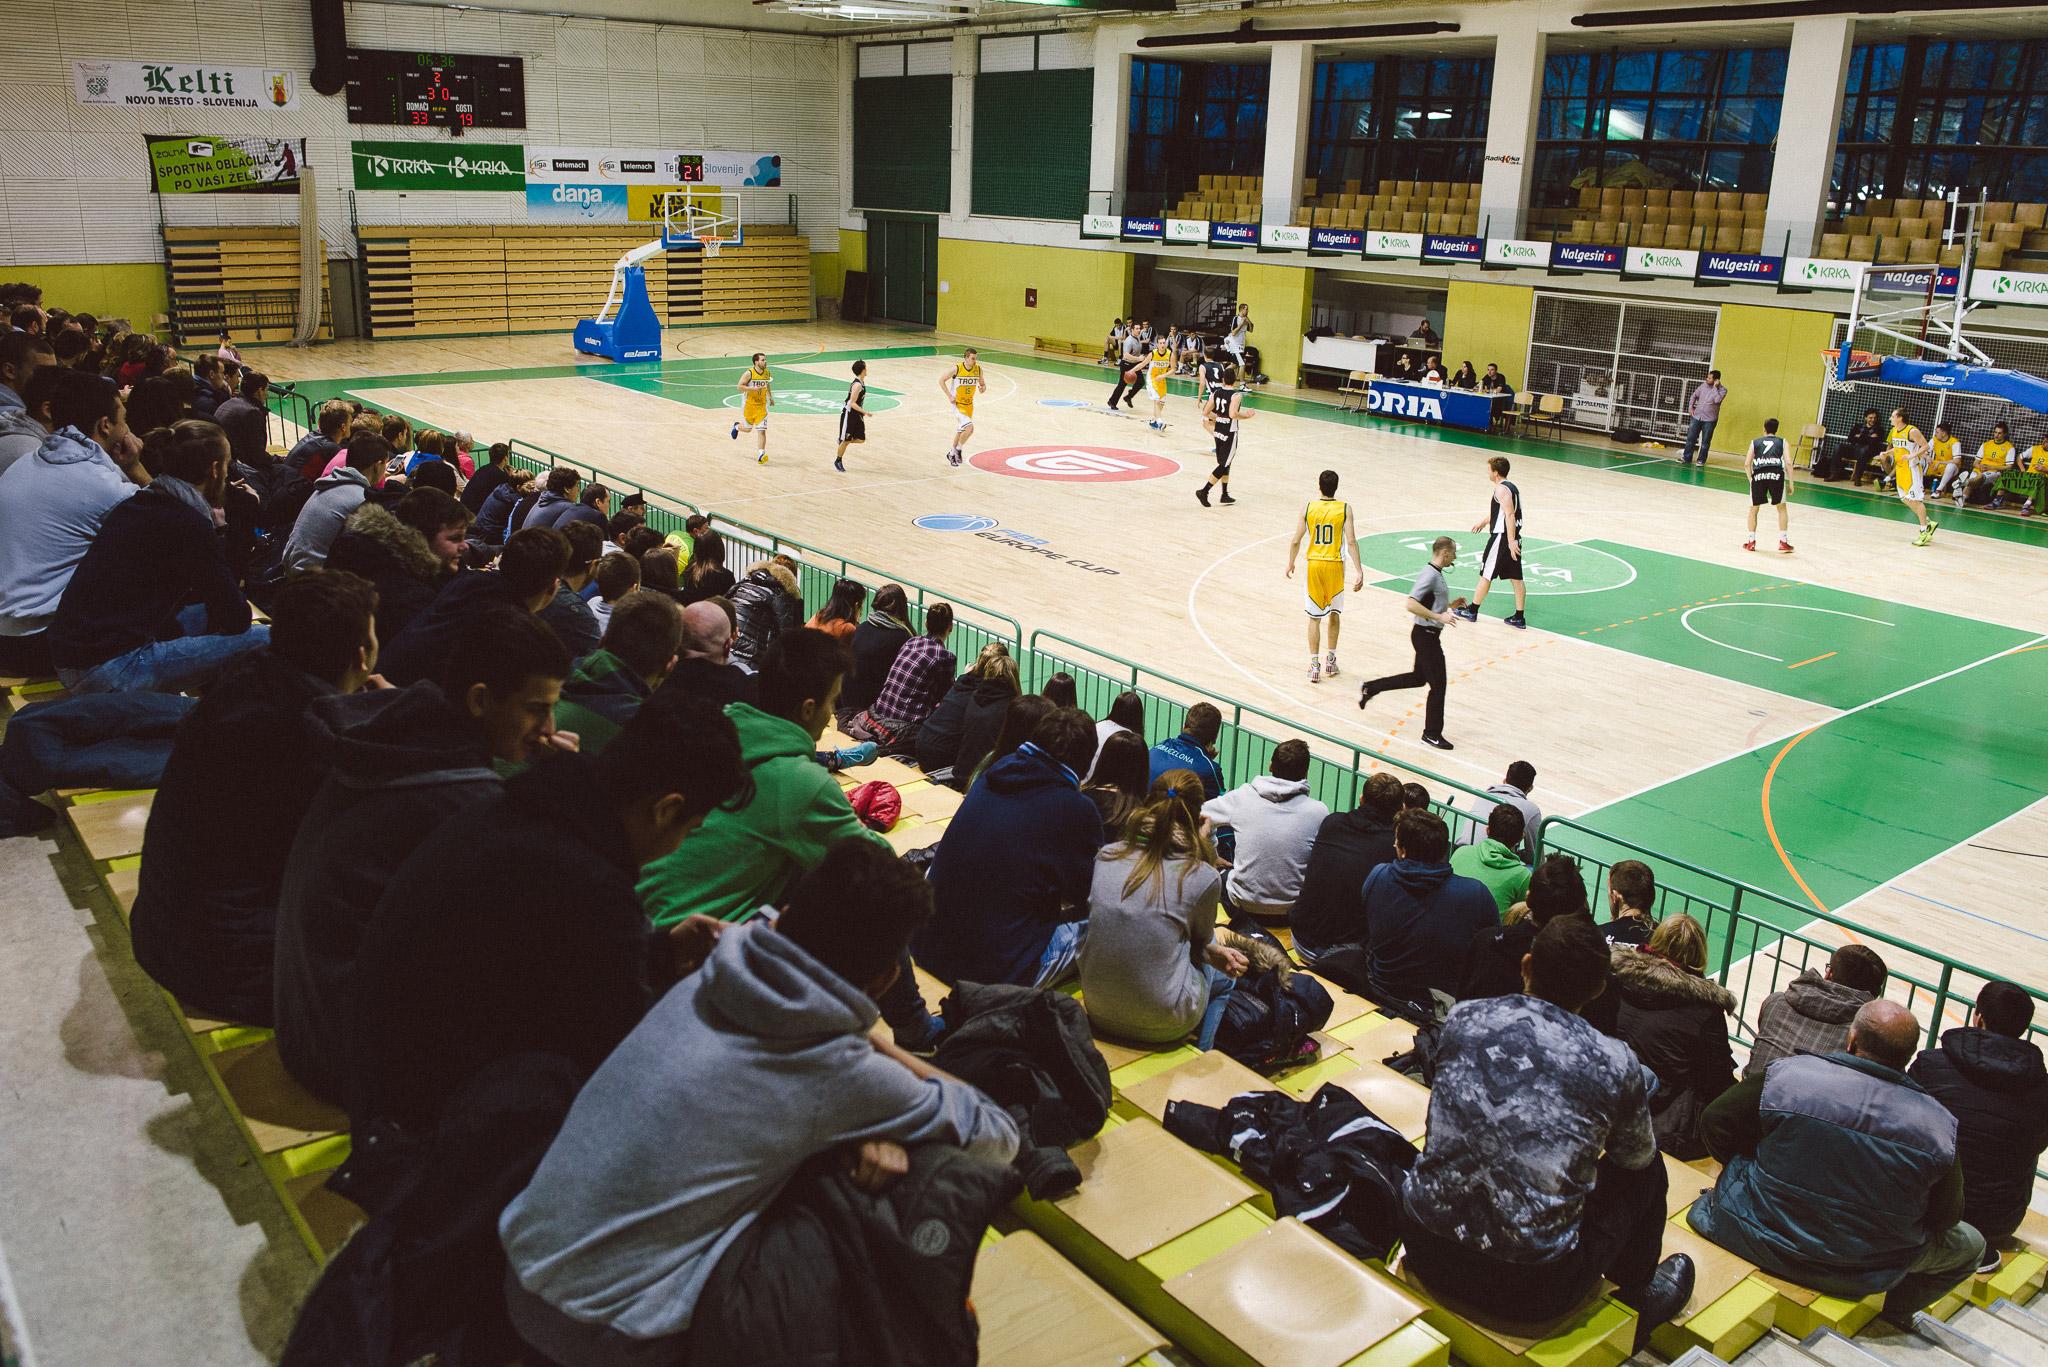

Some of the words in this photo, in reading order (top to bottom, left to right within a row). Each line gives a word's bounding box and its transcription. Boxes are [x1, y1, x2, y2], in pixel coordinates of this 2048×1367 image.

[141, 65, 235, 95] Kelti
[434, 72, 441, 83] 2
[427, 87, 435, 100] 3
[441, 87, 450, 101] 0
[125, 95, 156, 106] NOVO
[158, 96, 194, 106] MESTO
[202, 97, 259, 108] SLOVENIJA
[455, 103, 473, 113] GOSTI
[411, 111, 428, 125] 33
[460, 113, 473, 127] 19
[158, 160, 213, 178] ŠPORTNA
[393, 159, 436, 175] KRKA
[472, 160, 513, 176] KRKA
[555, 161, 586, 169] telemach
[704, 162, 744, 176] Slovenije
[684, 165, 702, 180] 21
[174, 179, 192, 191] PO
[195, 174, 225, 188] VAŠI
[652, 188, 685, 206] vaš
[649, 200, 703, 218] kanal
[1216, 226, 1247, 239] Nalgesin
[1317, 232, 1351, 246] Nalgesin
[1390, 238, 1411, 248] KRKA
[1430, 239, 1470, 253] Nalgesin
[1512, 247, 1537, 257] KRKA
[1560, 248, 1606, 263] Nalgesin
[1655, 256, 1683, 268] KRKA
[1709, 257, 1761, 273] Nalgesin
[1820, 267, 1851, 279] KRKA
[2013, 280, 2048, 294] KRKA
[623, 349, 658, 358] elan
[1762, 440, 1775, 455] 7
[1314, 523, 1334, 545] 10
[974, 531, 1068, 560] EUROPE
[1065, 559, 1121, 576] CUP
